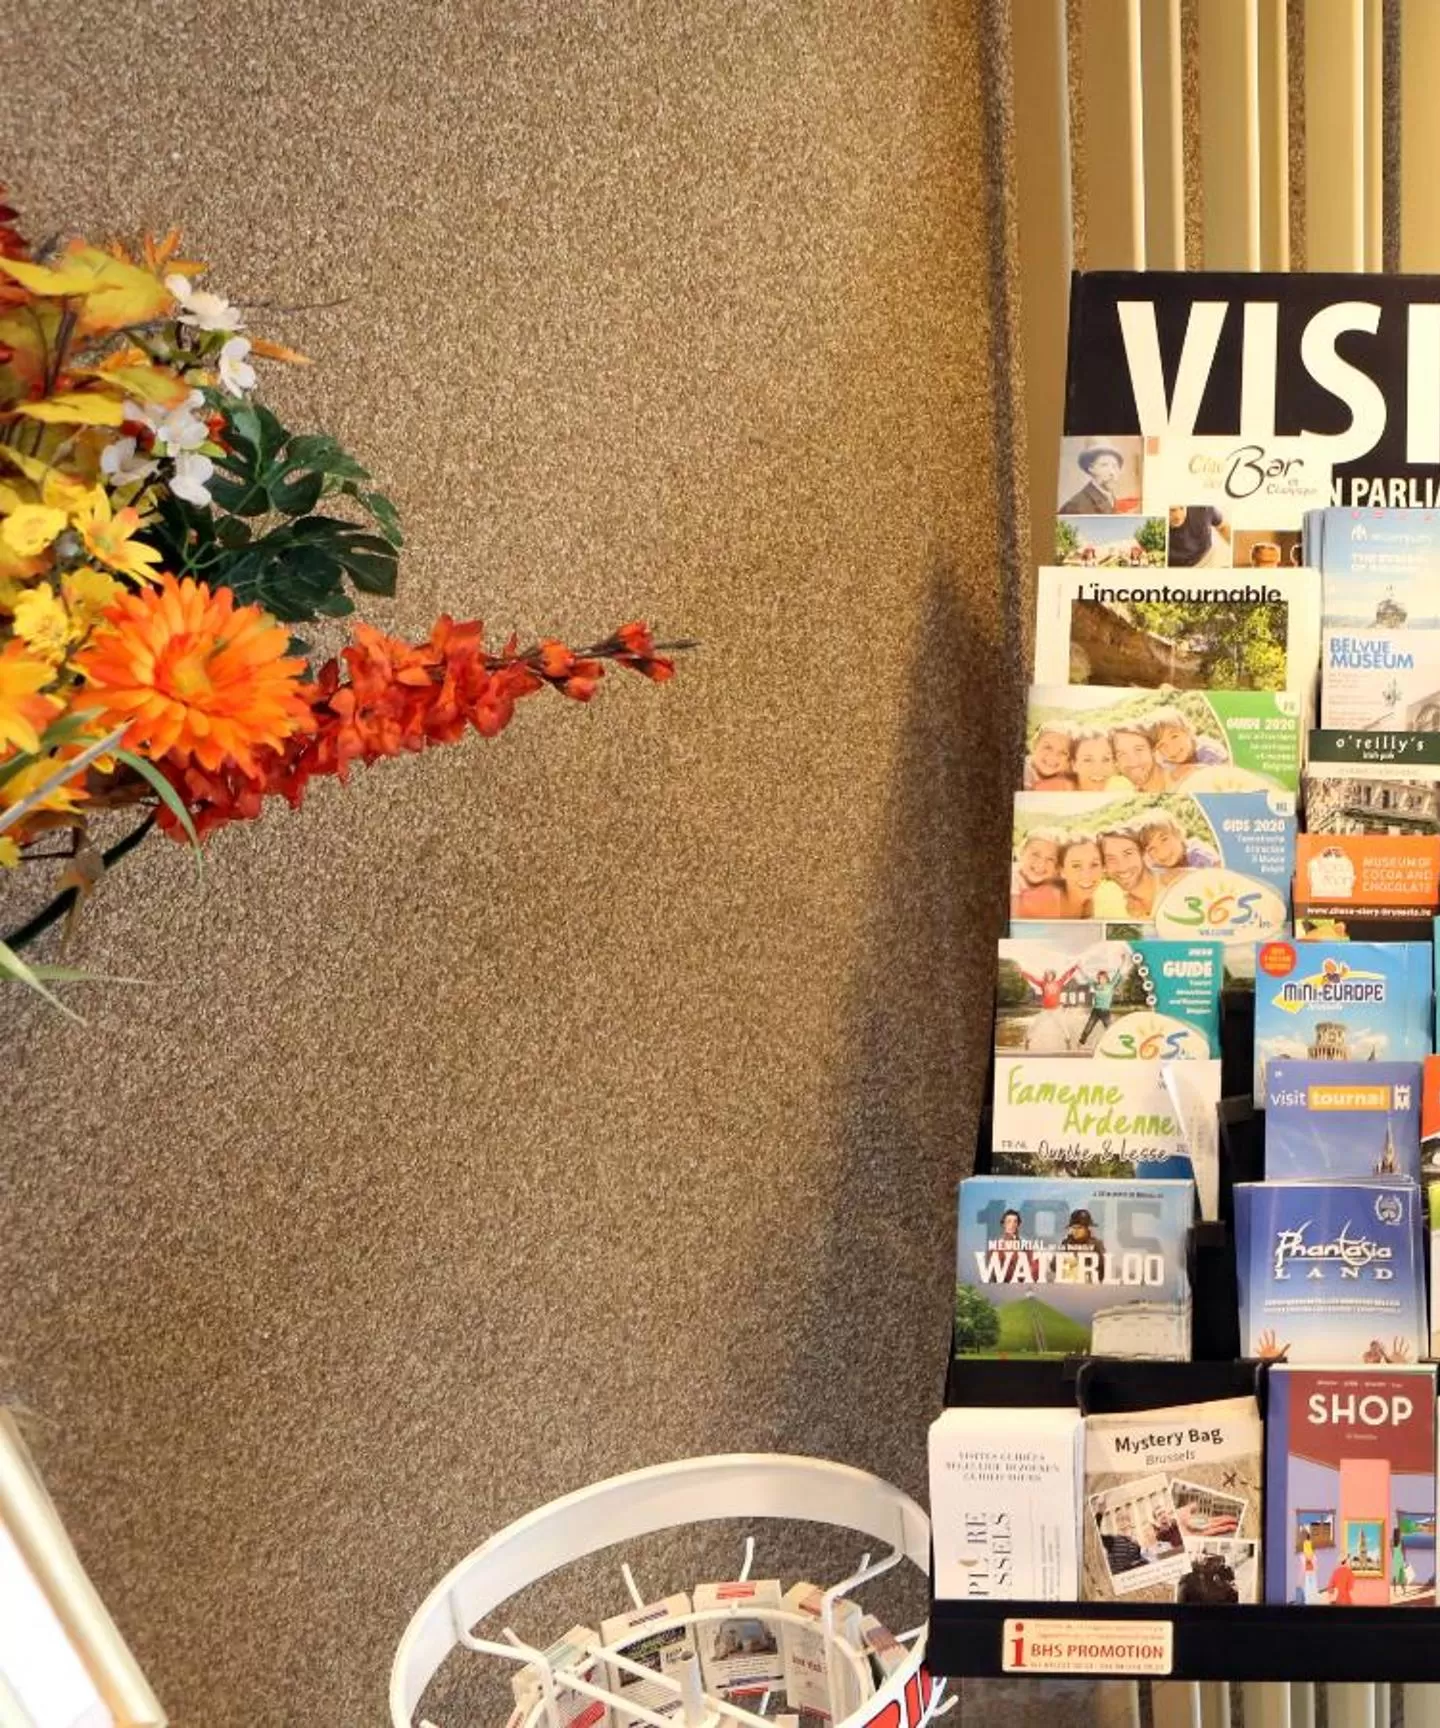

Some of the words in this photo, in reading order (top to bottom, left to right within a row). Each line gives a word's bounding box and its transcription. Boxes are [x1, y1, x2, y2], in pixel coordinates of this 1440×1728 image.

[1225, 445, 1304, 498] Bar
[1077, 583, 1281, 603] L'incontournable
[1330, 638, 1390, 654] BELVUE
[1330, 654, 1414, 669] MUSEUM
[1265, 718, 1295, 729] 2020
[1336, 735, 1425, 753] o'reilly's
[1253, 820, 1285, 832] 2020
[1163, 961, 1213, 977] GUIDE
[1007, 1065, 1124, 1105] Famenne
[1270, 1090, 1306, 1107] visit
[1311, 1090, 1386, 1107] tournai
[1062, 1105, 1176, 1136] Ardenne
[1038, 1140, 1092, 1162] Ourthe
[1102, 1141, 1114, 1160] &
[1120, 1140, 1168, 1162] Lesse
[1274, 1219, 1392, 1269] Phantasia
[974, 1251, 1164, 1286] WATERLOO
[1274, 1268, 1393, 1281] LAND
[1308, 1393, 1413, 1426] SHOP
[1115, 1430, 1184, 1453] Mystery
[1188, 1428, 1224, 1444] Bag
[1145, 1450, 1196, 1466] Brussels
[1031, 1643, 1063, 1657] BHS
[1067, 1644, 1163, 1658] PROMOTION
